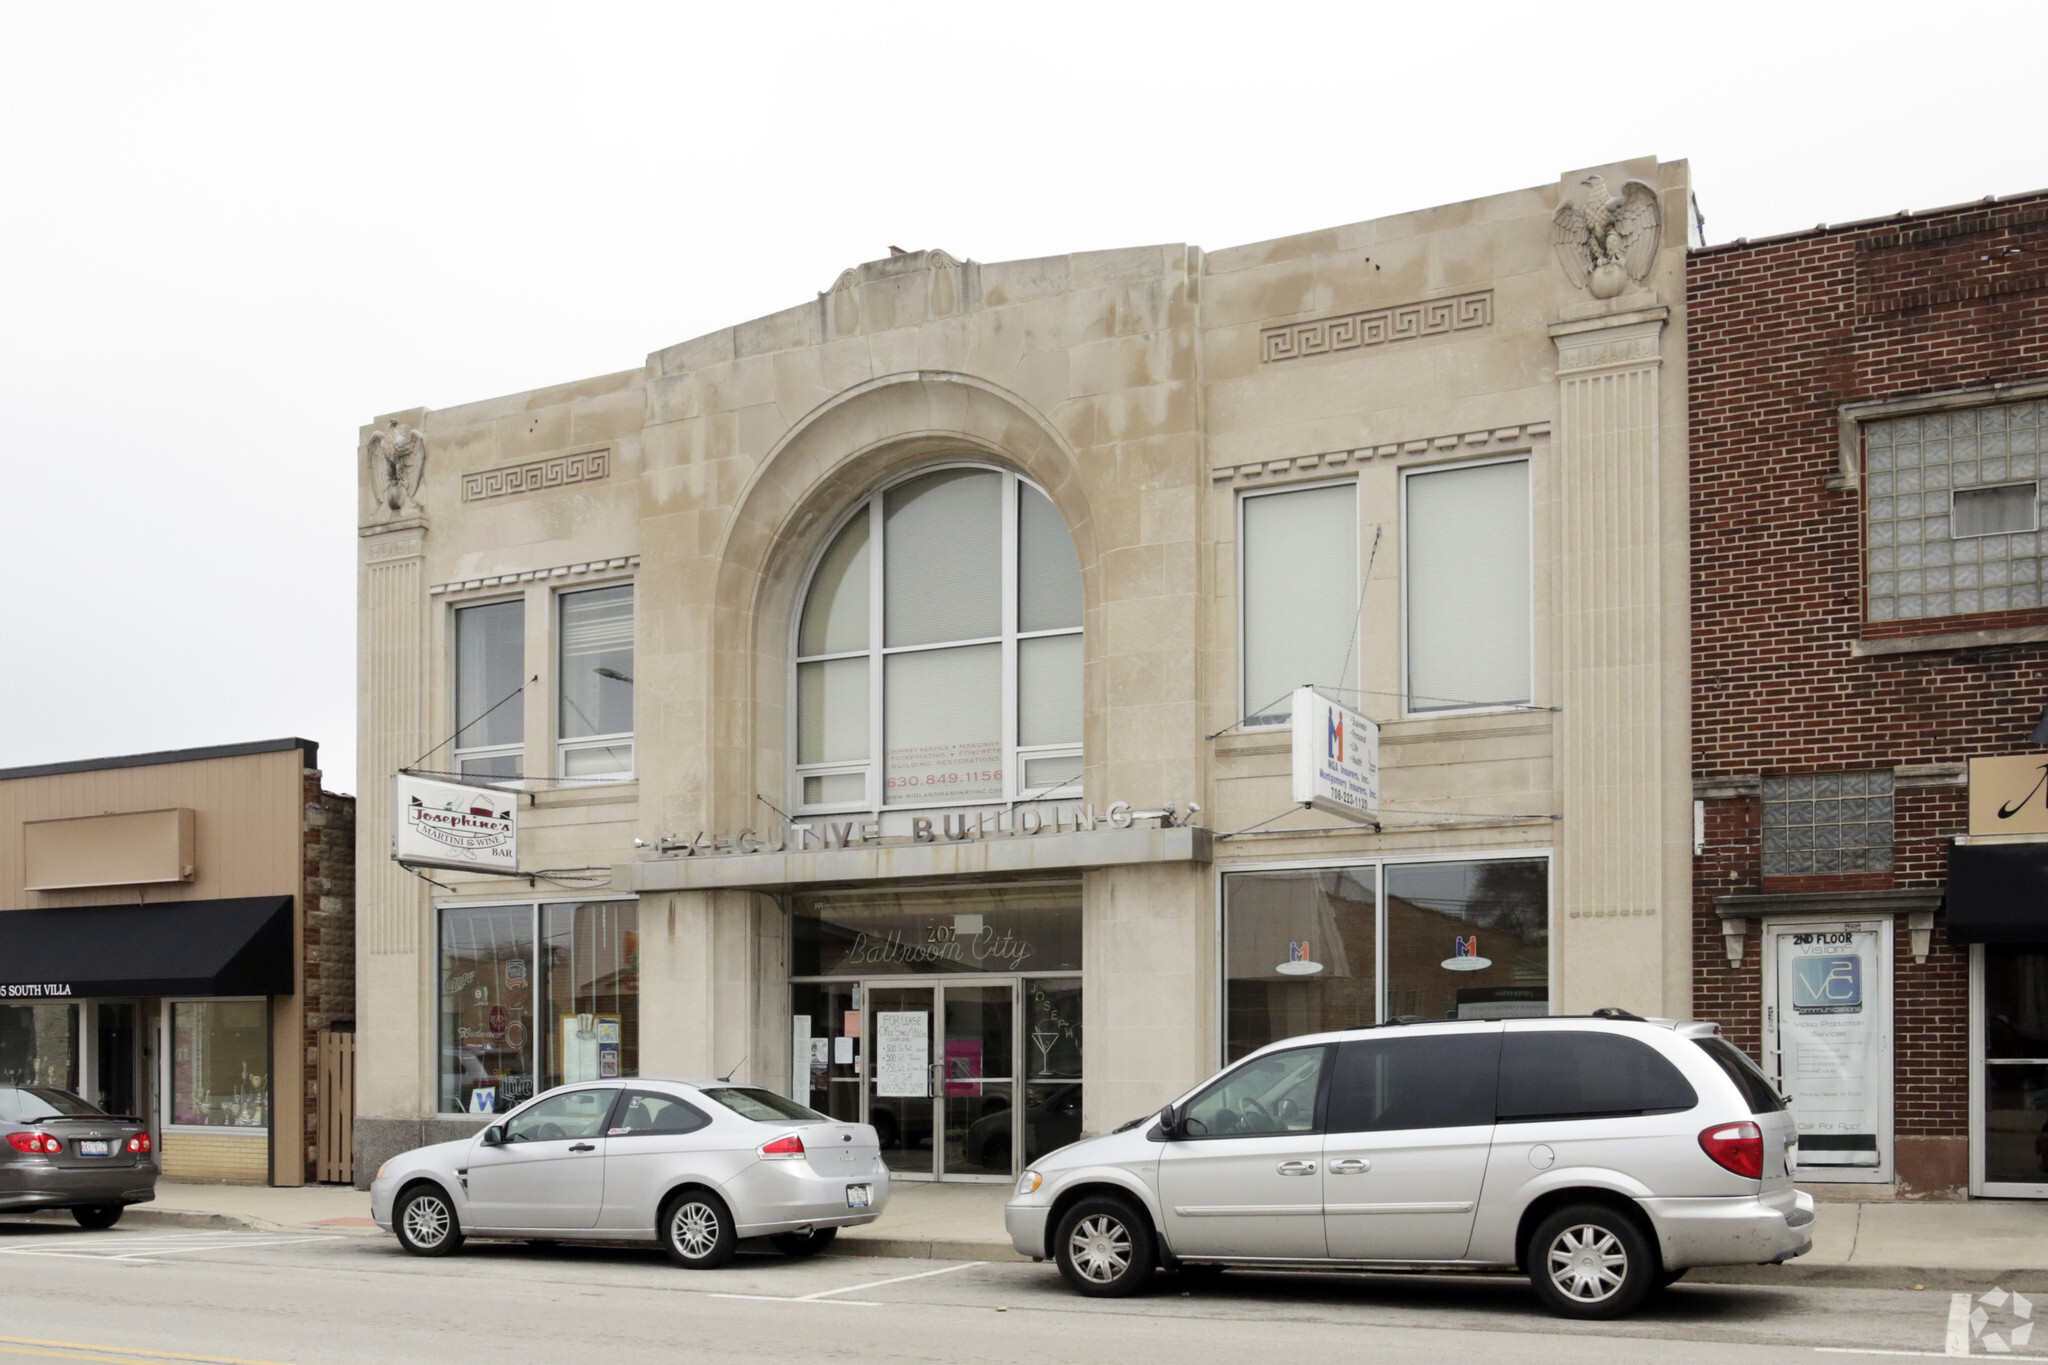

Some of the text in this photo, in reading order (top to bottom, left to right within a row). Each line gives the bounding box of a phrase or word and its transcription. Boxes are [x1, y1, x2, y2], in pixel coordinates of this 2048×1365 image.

[891, 747, 1002, 761] TUCKPOINTING CONCRETE
[891, 756, 1001, 769] BUILDING RESTORATIONS
[887, 770, 1002, 788] 630.849.1156
[1320, 768, 1347, 790] Montgomery
[1331, 787, 1368, 810] 708-223-1120
[411, 808, 511, 832] Josephine's
[422, 825, 501, 847] MARTINI & WINE
[658, 801, 1132, 858] EXECUTIVE BUILDING
[492, 848, 513, 858] BAR
[926, 925, 958, 943] 207
[1793, 932, 1853, 946] 2ND FLOOR
[849, 925, 1032, 970] Ballroom City
[8, 984, 42, 997] SOUTH
[44, 983, 72, 996] VILLA
[883, 1014, 922, 1026] FOR LEASE
[476, 1091, 495, 1112] W
[1798, 1122, 1815, 1130] Call
[1819, 1122, 1833, 1130] For
